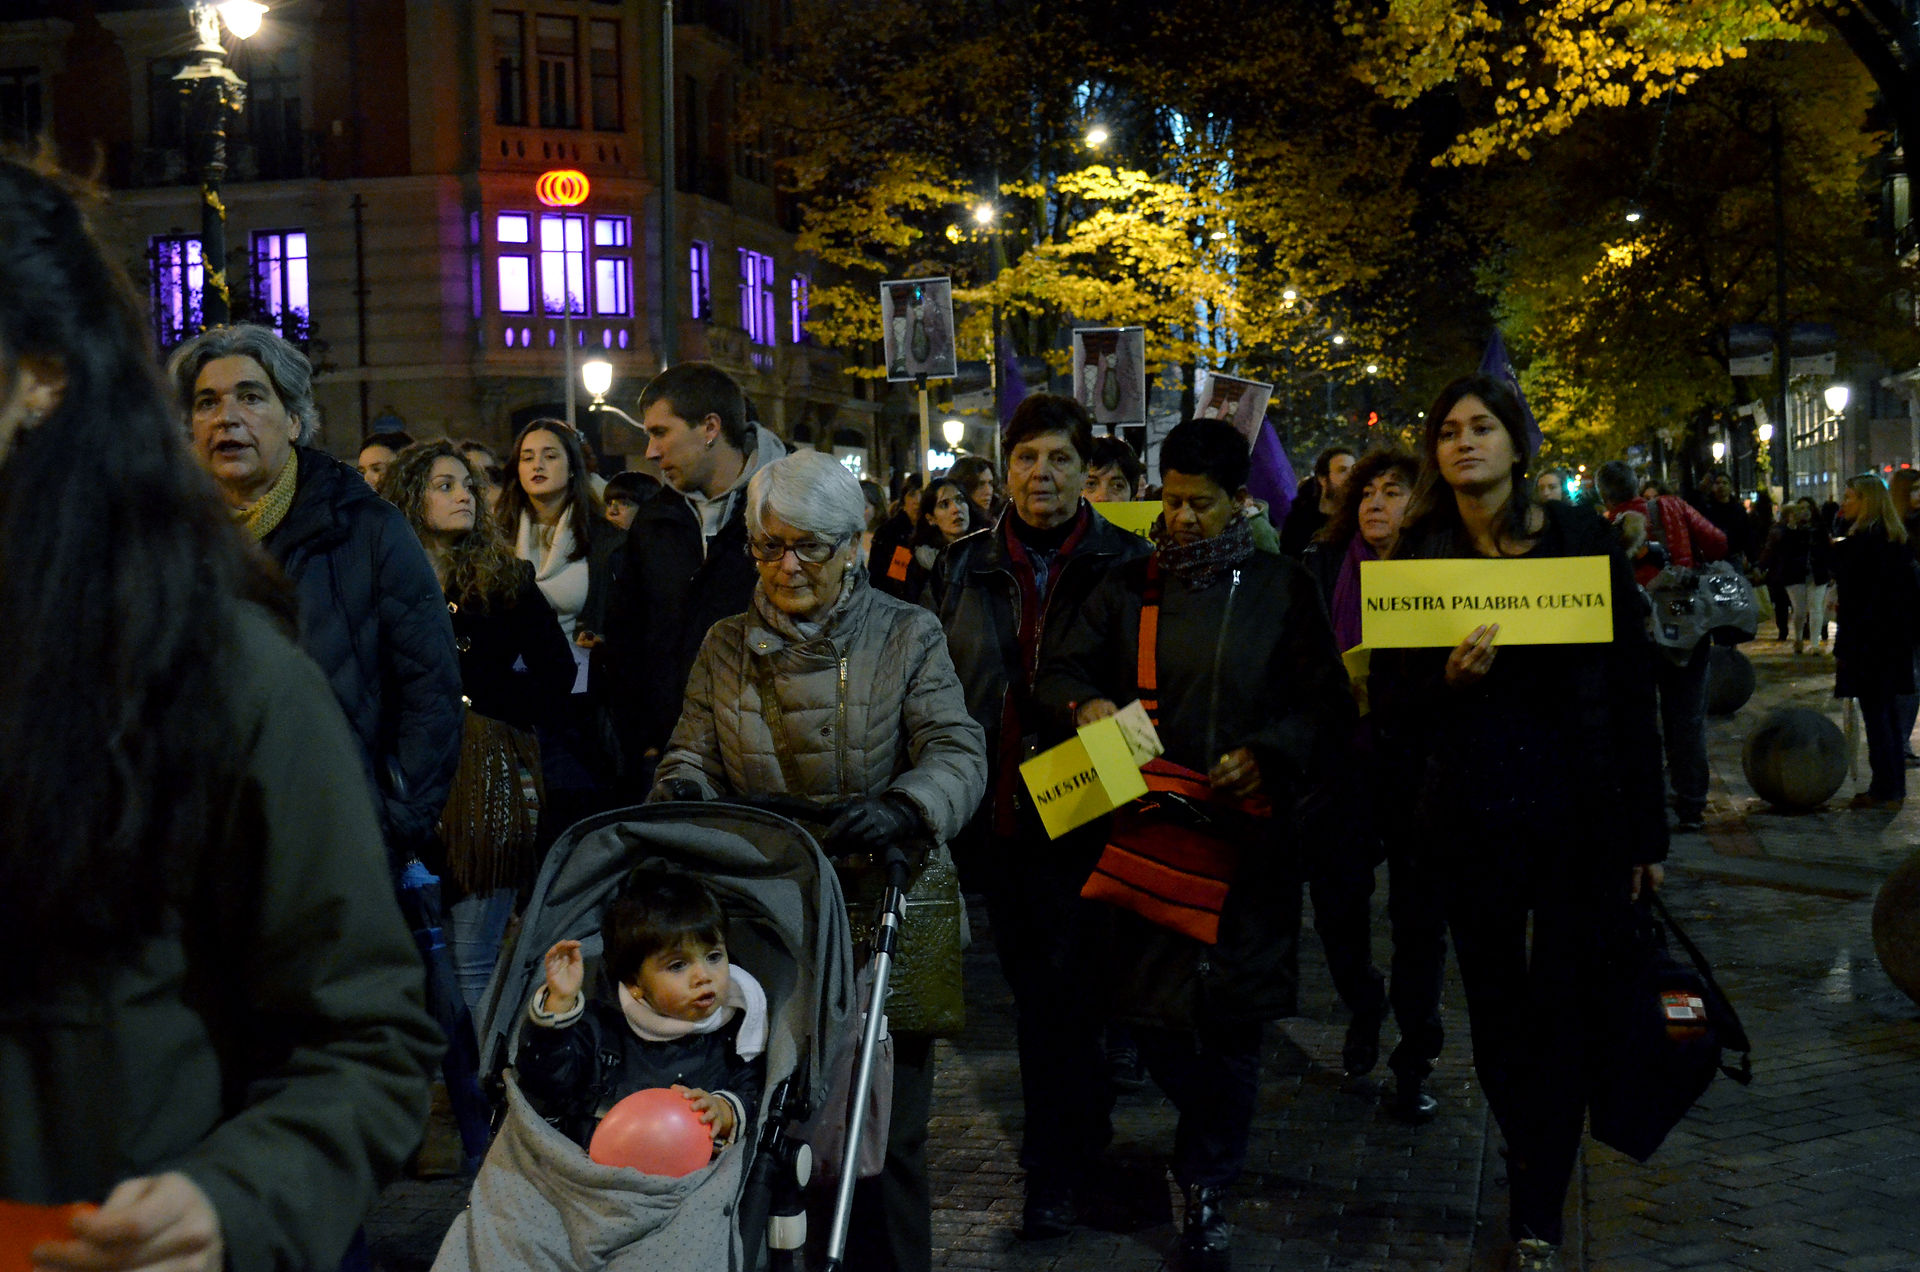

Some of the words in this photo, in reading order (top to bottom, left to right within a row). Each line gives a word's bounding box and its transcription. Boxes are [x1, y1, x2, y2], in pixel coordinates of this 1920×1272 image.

[1367, 595, 1445, 612] NUESTRA
[1452, 594, 1530, 611] PALABRA
[1537, 593, 1606, 610] CUENTA
